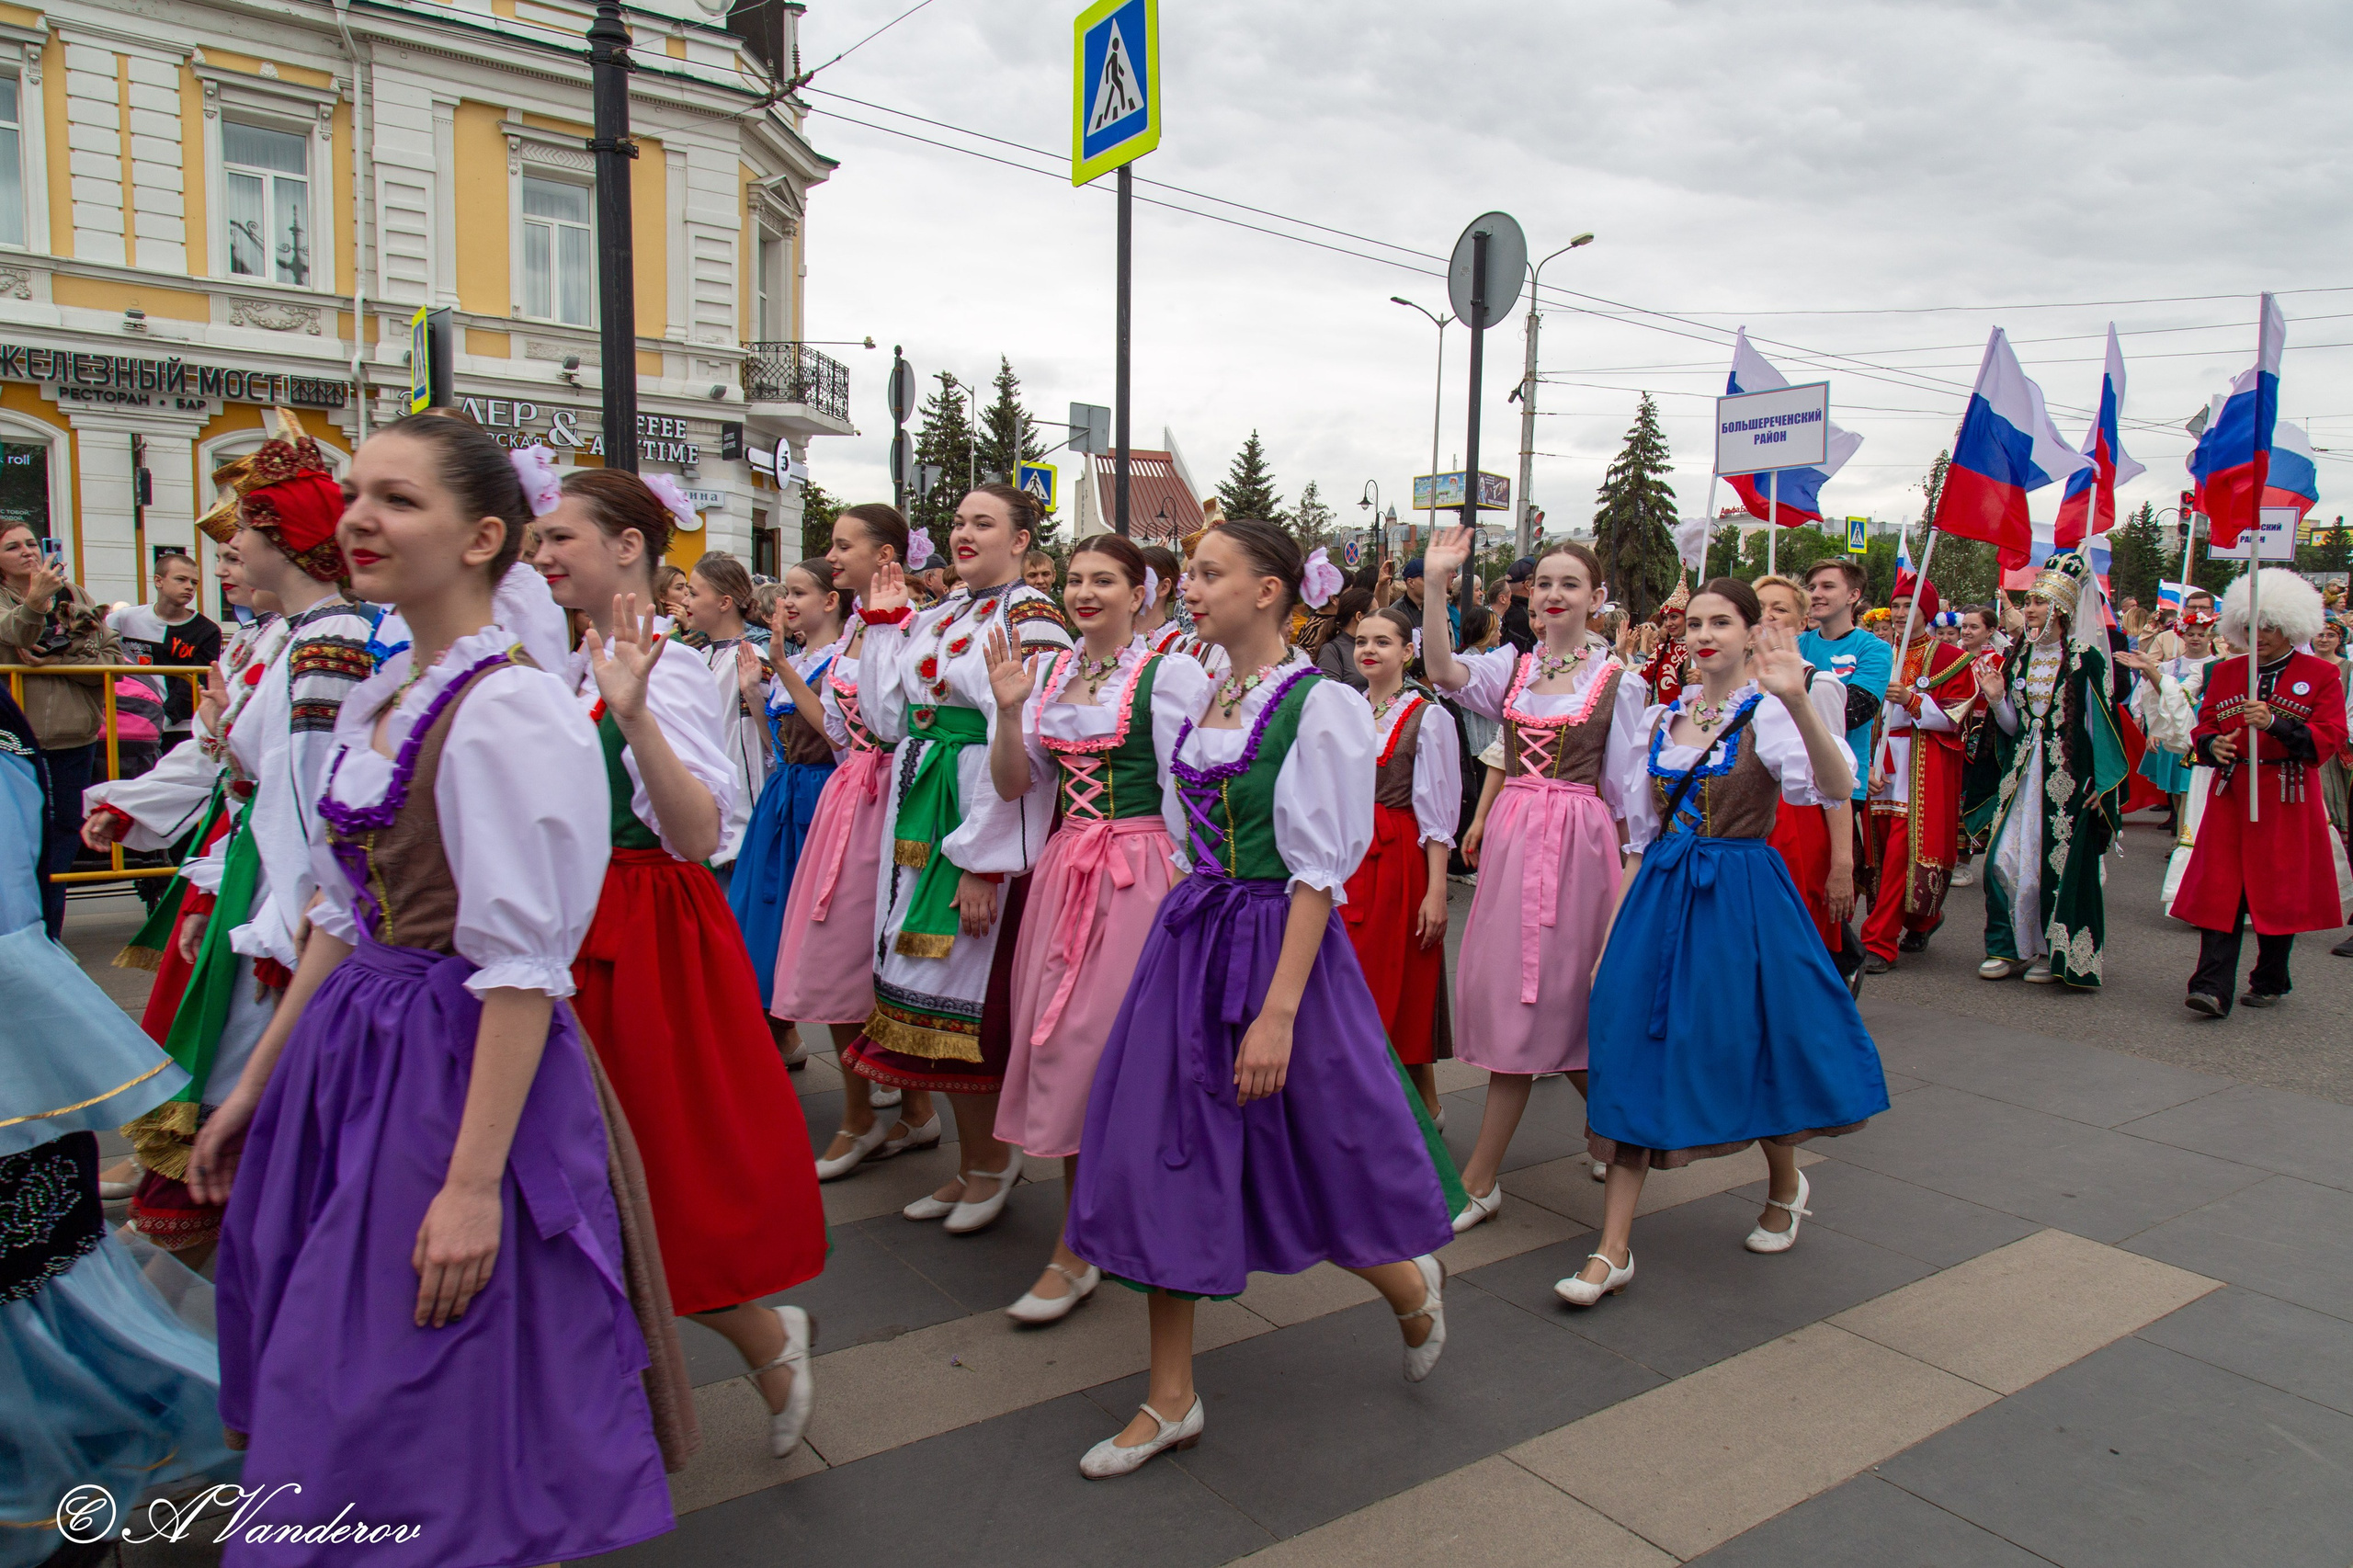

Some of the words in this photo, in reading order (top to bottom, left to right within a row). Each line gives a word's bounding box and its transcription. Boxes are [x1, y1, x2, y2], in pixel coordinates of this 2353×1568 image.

[0, 345, 187, 395] ЖЕЛЕЗНЫЙ
[198, 366, 281, 403] МОСТ
[59, 386, 150, 406] РЕСТОРАН
[176, 398, 207, 411] БАР
[1722, 408, 1822, 434] БОЛЬШЕРЕЧЕНСКИЙ
[589, 435, 699, 465] ATIME
[1754, 430, 1787, 445] РАЙОН
